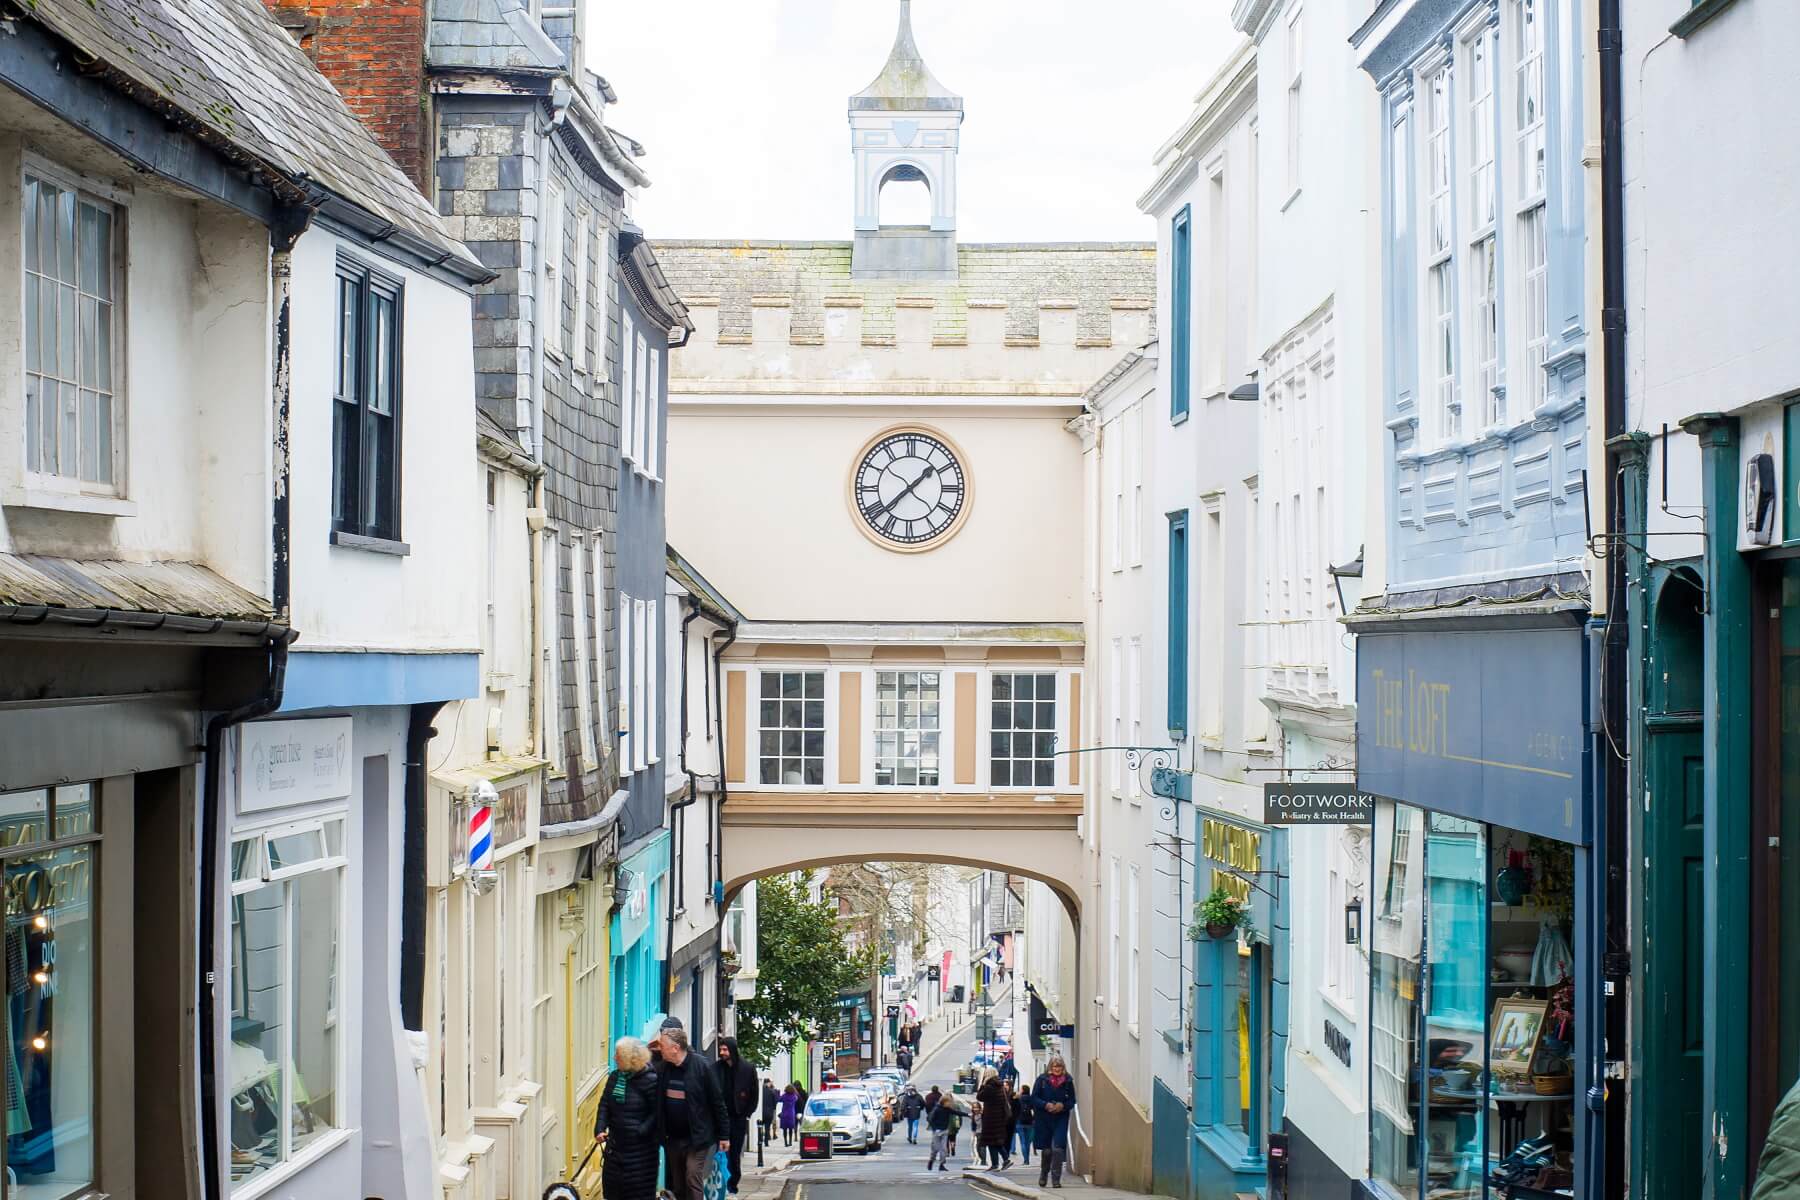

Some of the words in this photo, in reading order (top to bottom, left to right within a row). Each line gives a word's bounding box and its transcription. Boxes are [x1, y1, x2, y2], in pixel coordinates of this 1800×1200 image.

[1373, 668, 1403, 749] THE
[1408, 669, 1451, 757] LOFT
[1313, 812, 1320, 820] &
[1321, 811, 1339, 820] Foot
[1339, 811, 1365, 820] Health
[42, 941, 57, 966] DIO
